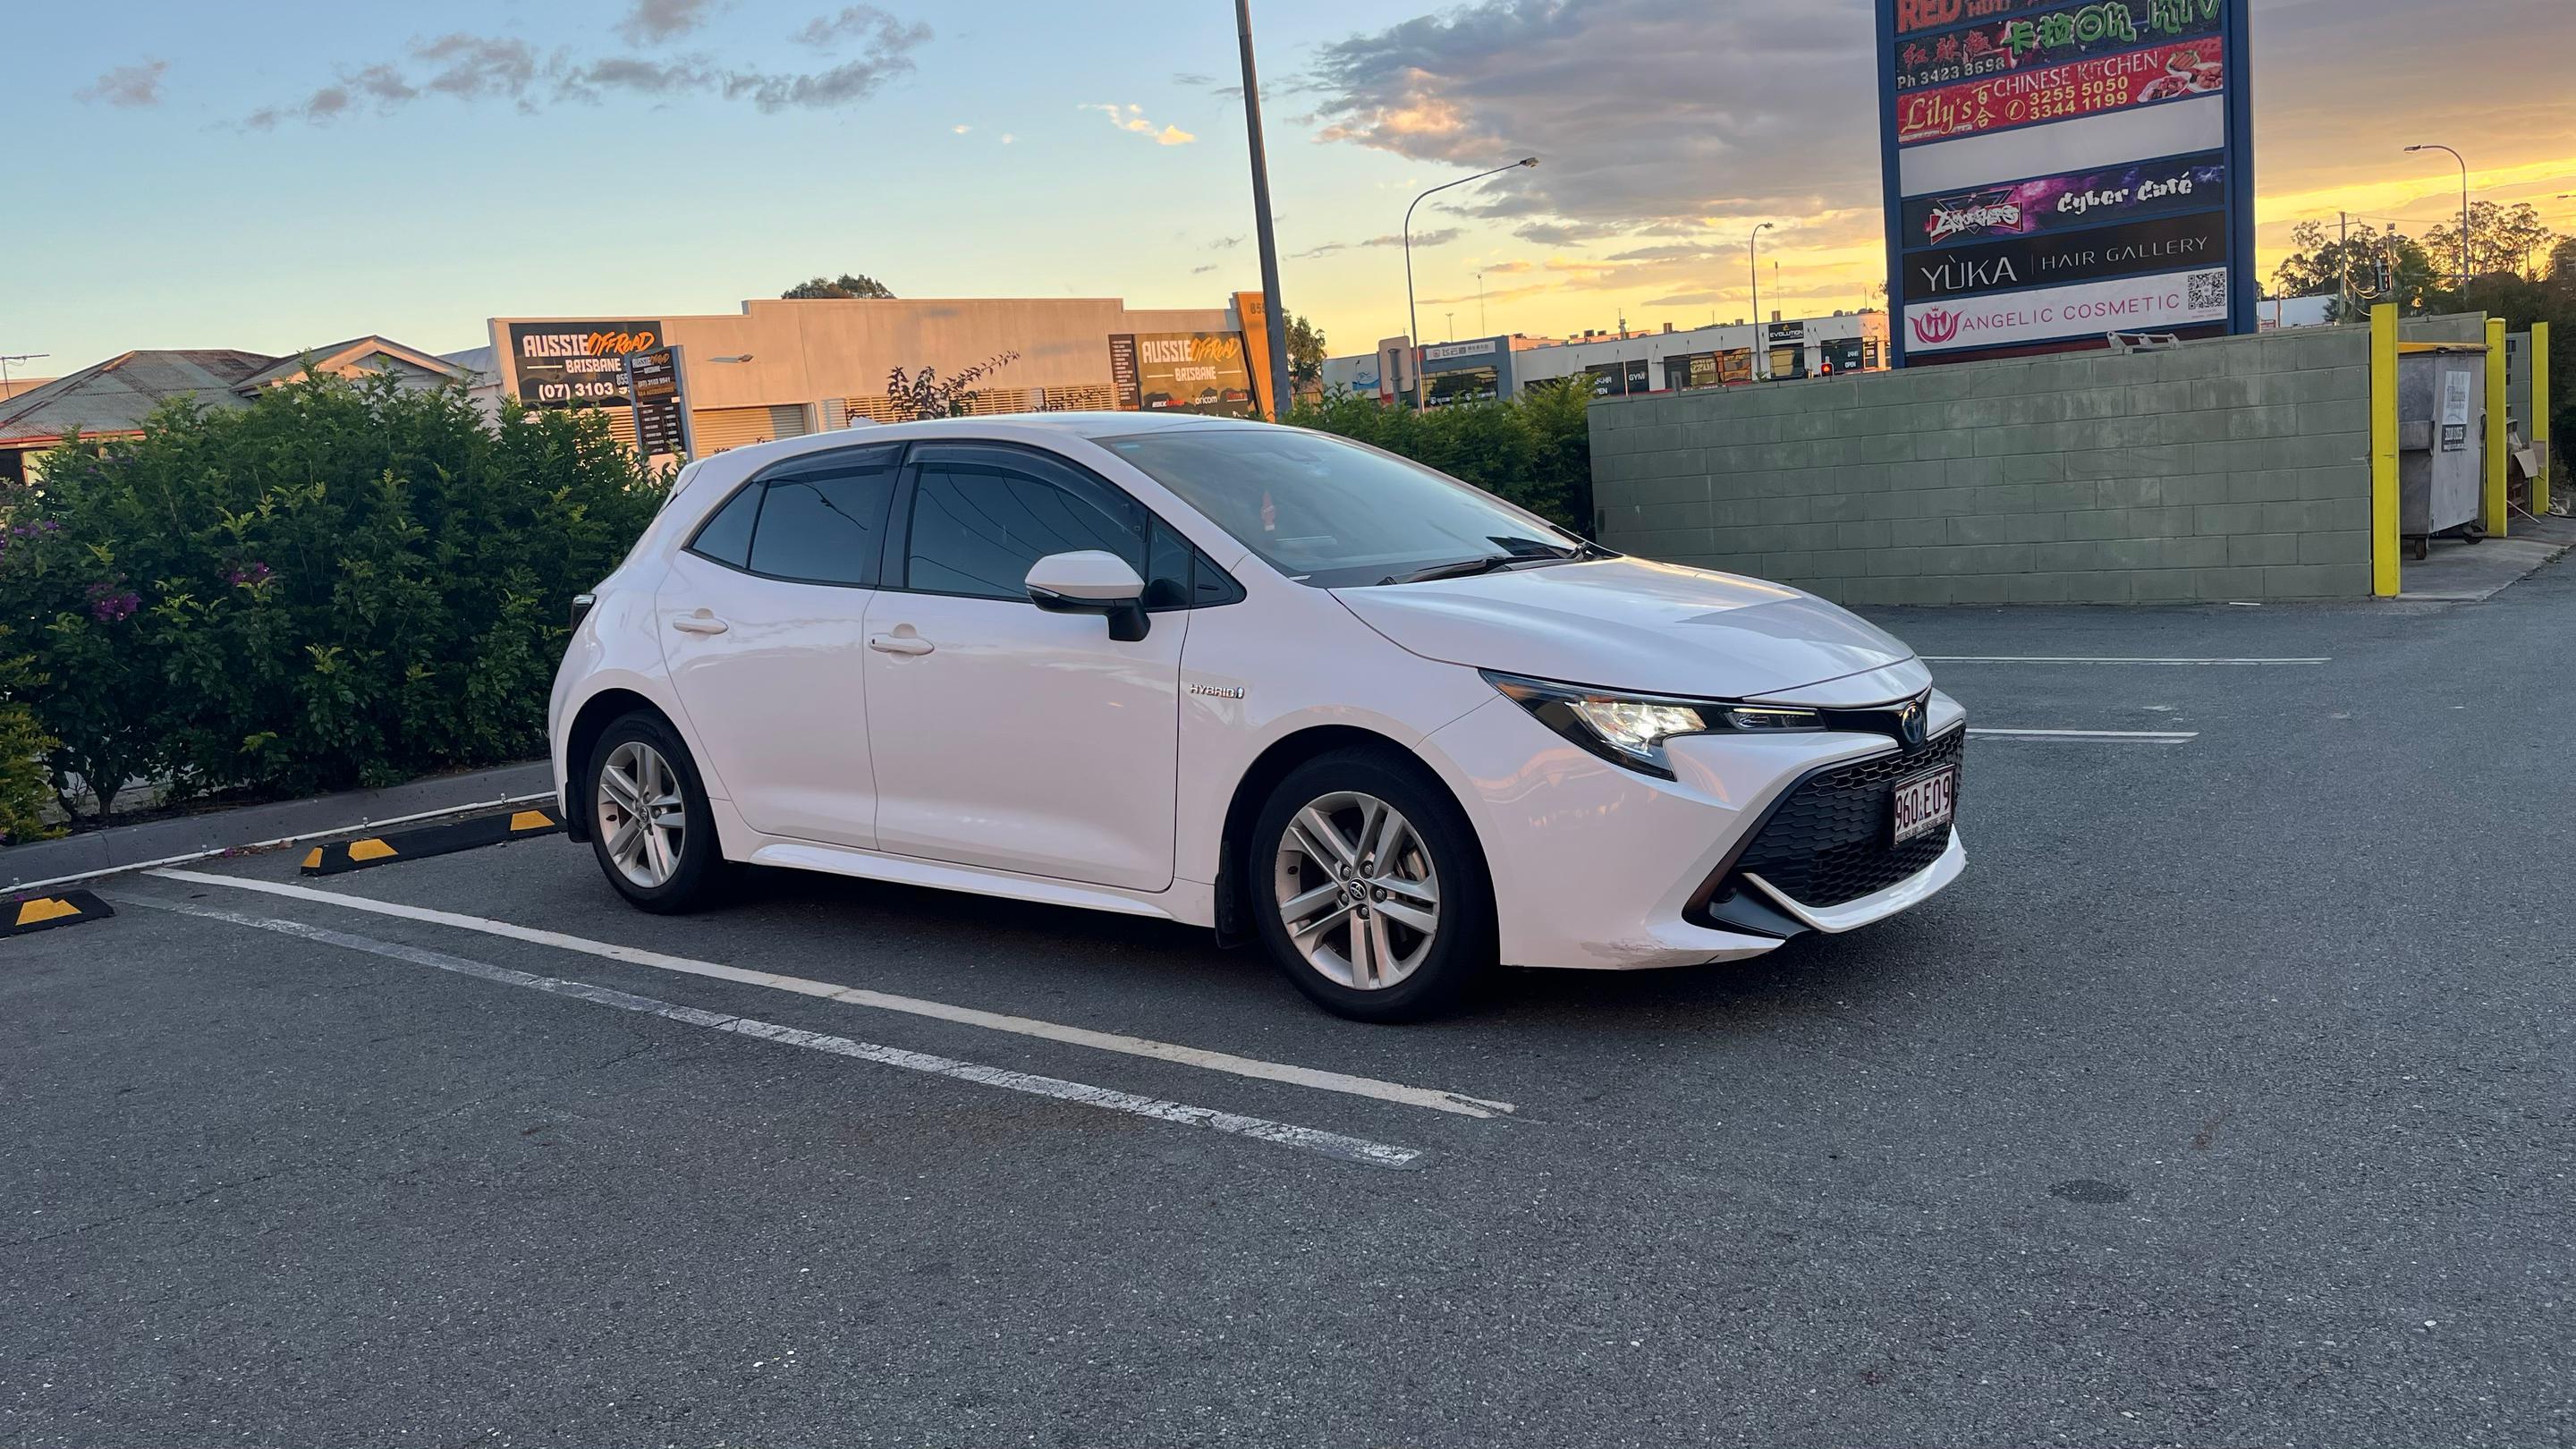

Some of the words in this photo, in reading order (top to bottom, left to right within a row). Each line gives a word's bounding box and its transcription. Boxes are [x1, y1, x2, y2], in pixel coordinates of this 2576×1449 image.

[1897, 74, 1916, 89] Ph
[1920, 65, 1960, 86] 3423
[1994, 67, 2071, 97] CHINESE
[2078, 51, 2158, 81] KITCHEN
[2029, 85, 2075, 106] 3255
[2081, 76, 2129, 96] 5050
[1901, 95, 1972, 135] Lily's
[2030, 99, 2075, 120] 3344
[2082, 91, 2128, 110] 1199
[2057, 189, 2129, 215] Cyber
[2138, 171, 2192, 201] Café
[2042, 251, 2095, 270] HAIR
[2106, 236, 2207, 261] GALLERY
[1962, 308, 2053, 331] ANGELIC
[2063, 293, 2180, 320] COSMETIC
[1770, 329, 1803, 338] EVOLUTION
[523, 335, 589, 357] AUSSIE
[1142, 340, 1191, 363] AUSSIE
[565, 359, 622, 373] BRISBANE
[1174, 366, 1217, 382] BRISBANE
[1629, 372, 1646, 381] GYM
[538, 383, 571, 402] (07)
[574, 382, 614, 396] 3103
[1195, 394, 1218, 405] oricom
[1191, 683, 1235, 699] HYBRID
